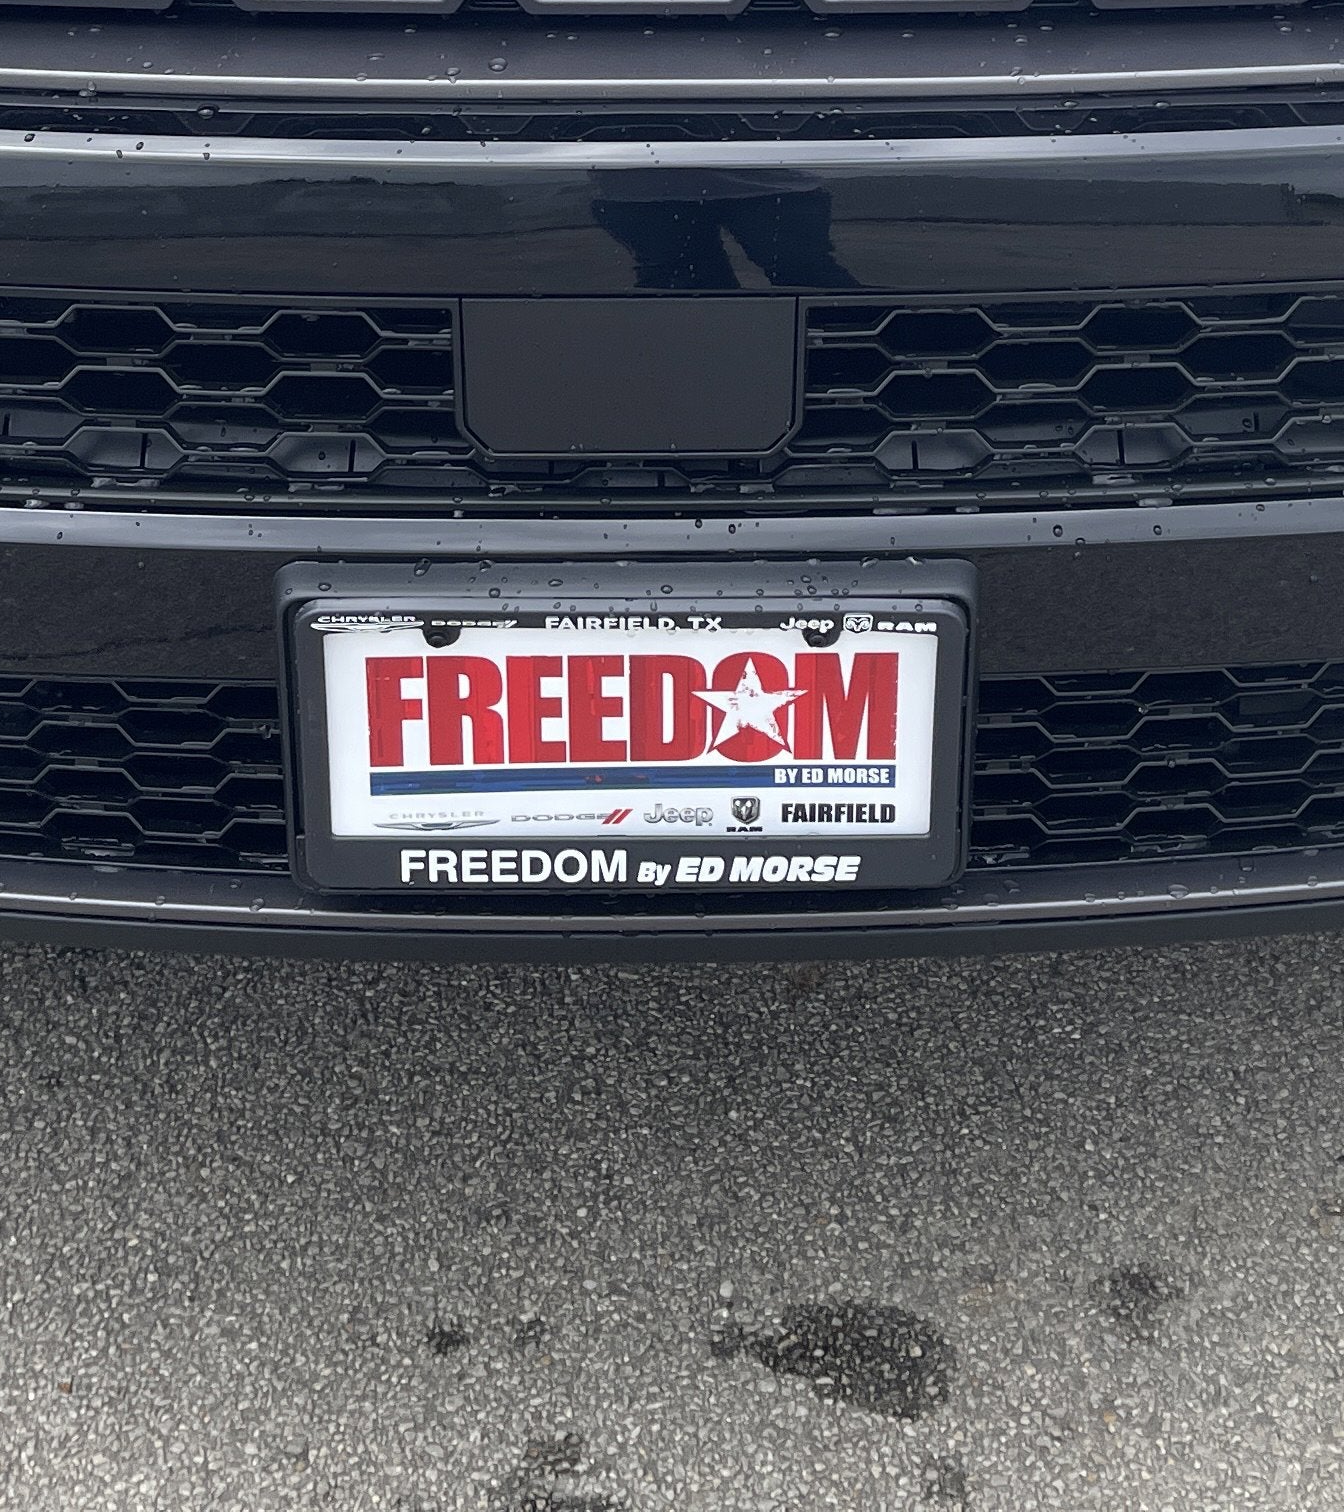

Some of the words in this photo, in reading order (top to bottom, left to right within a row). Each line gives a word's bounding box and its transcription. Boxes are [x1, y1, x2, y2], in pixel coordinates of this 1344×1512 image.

[687, 616, 723, 631] TX
[780, 616, 835, 633] Jeep
[877, 621, 937, 632] RAM
[365, 651, 899, 767] FREEDOM
[774, 768, 798, 784] BY
[802, 768, 825, 784] ED
[828, 768, 890, 784] MORSE
[389, 810, 485, 819] CHRYSLER
[644, 803, 713, 827] Jeep
[781, 803, 896, 823] FAIRFIELD
[400, 848, 628, 884] FREEDOM
[637, 861, 671, 886] By
[675, 856, 725, 883] ED
[729, 856, 862, 883] MORSE
